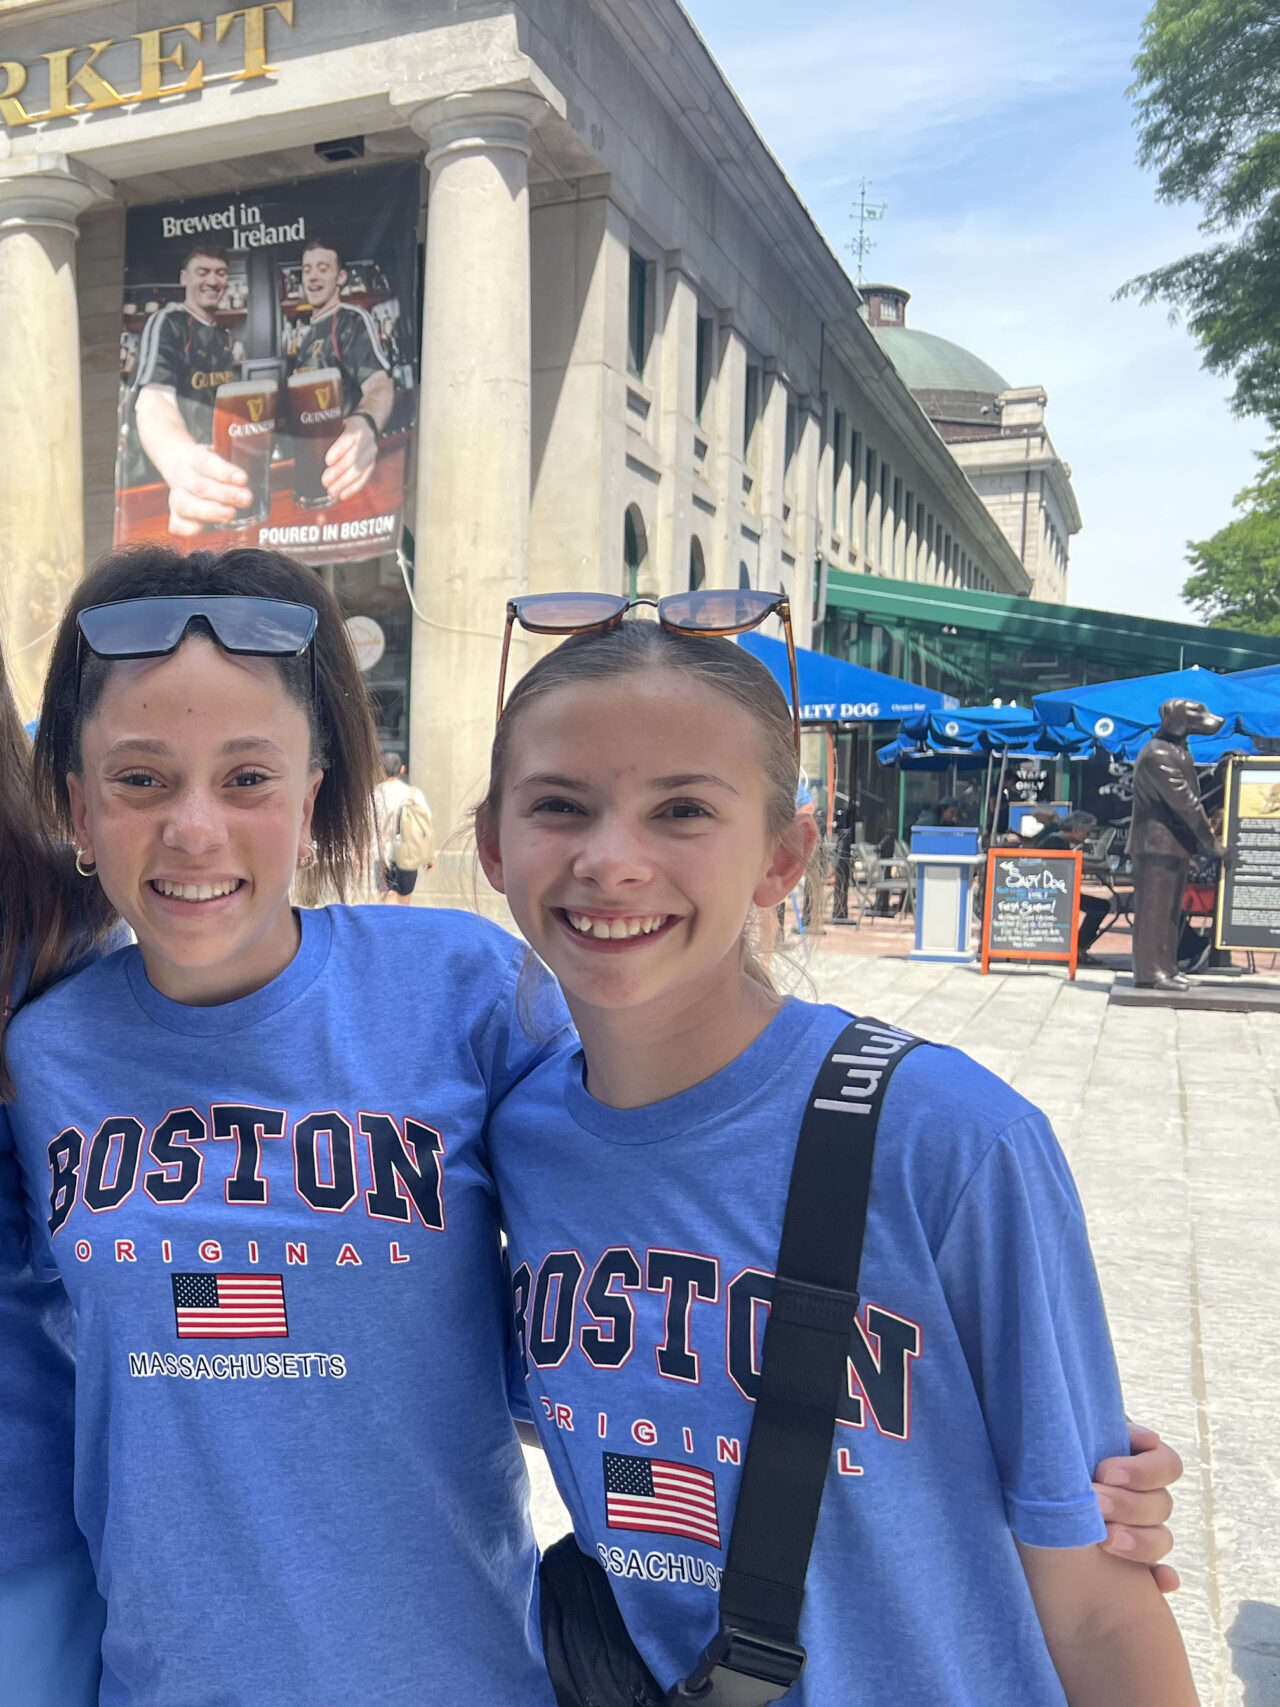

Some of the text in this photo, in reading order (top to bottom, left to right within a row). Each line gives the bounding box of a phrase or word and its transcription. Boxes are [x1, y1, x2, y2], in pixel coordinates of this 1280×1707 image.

[162, 203, 261, 238] Brewed in
[232, 217, 305, 249] Ireland
[228, 419, 276, 438] GUINNESS
[300, 407, 343, 425] GUINNESS
[258, 526, 320, 545] POURED
[322, 524, 338, 541] IN
[341, 514, 396, 539] BOSTON
[840, 702, 880, 718] DOG
[46, 1103, 446, 1241] BOSTON
[75, 1239, 411, 1266] ORIGINAL
[129, 1352, 348, 1380] MASSACHUSETTS
